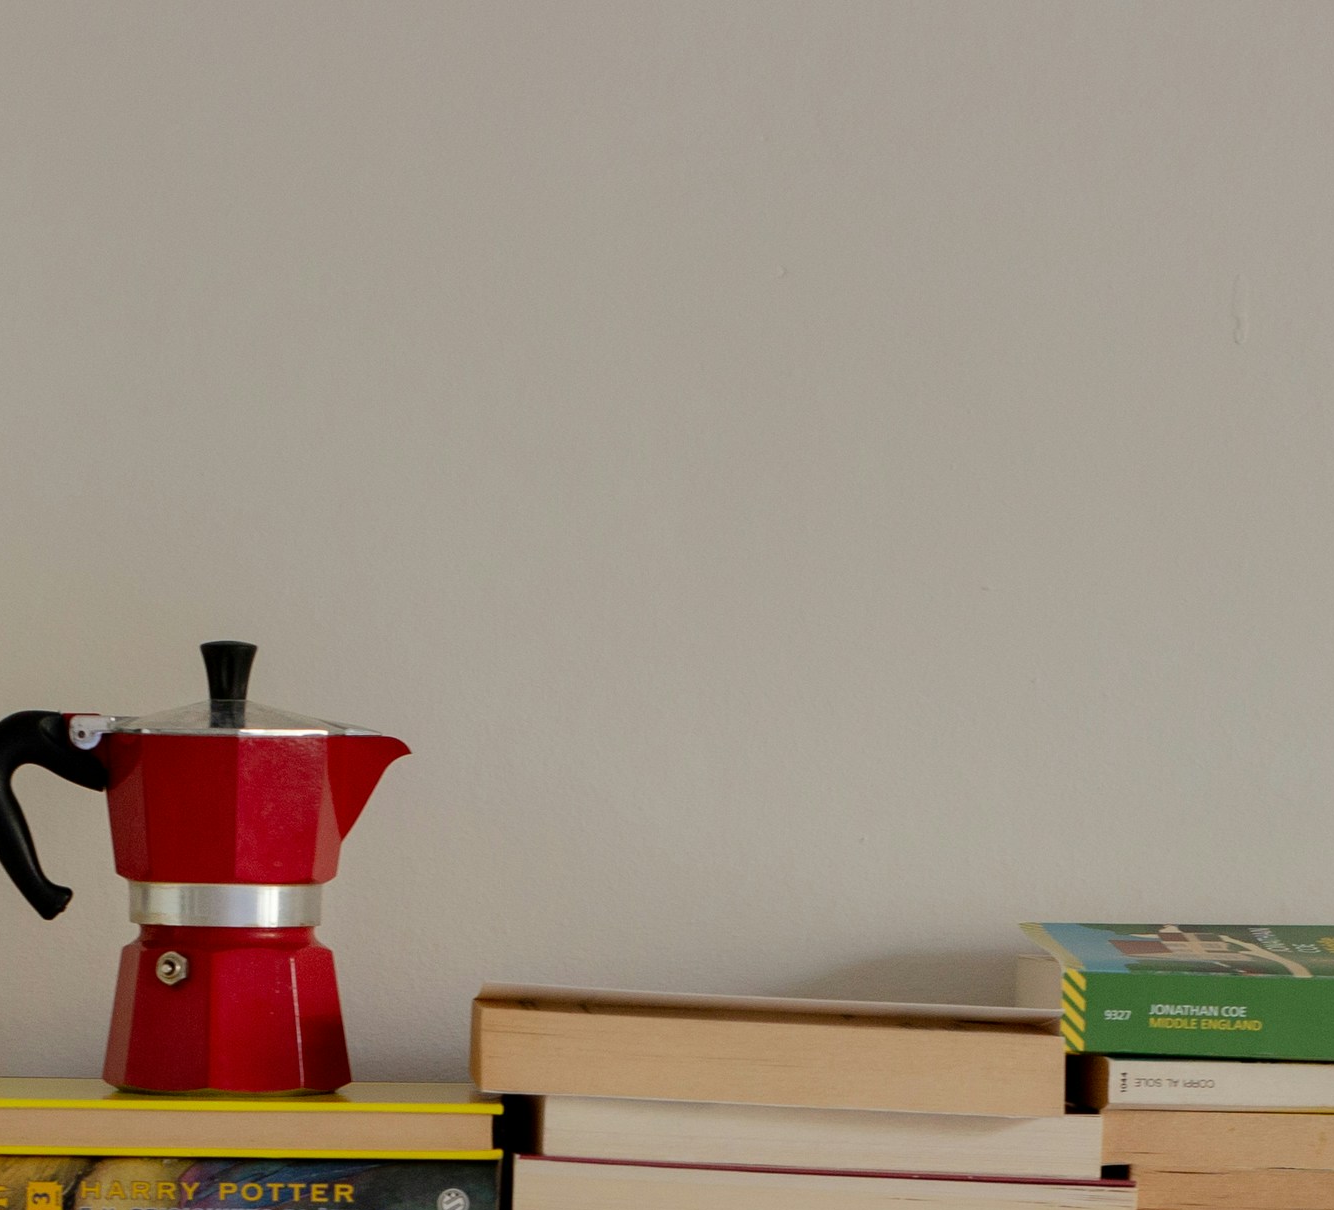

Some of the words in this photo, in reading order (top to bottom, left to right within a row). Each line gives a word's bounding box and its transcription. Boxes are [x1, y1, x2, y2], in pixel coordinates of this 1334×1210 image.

[1104, 1009, 1132, 1021] 9327
[1149, 1004, 1218, 1017] JONATHAN
[1220, 1006, 1247, 1018] COE
[1149, 1017, 1198, 1030] MIDDLE
[1200, 1019, 1263, 1032] ENGLAND
[1119, 1071, 1128, 1093] 1044
[1134, 1077, 1163, 1088] SOLE
[1166, 1078, 1180, 1088] AL
[1183, 1078, 1215, 1089] CORPI
[80, 1180, 200, 1201] HARRY
[219, 1181, 355, 1203] POTTER
[31, 1192, 51, 1205] 3
